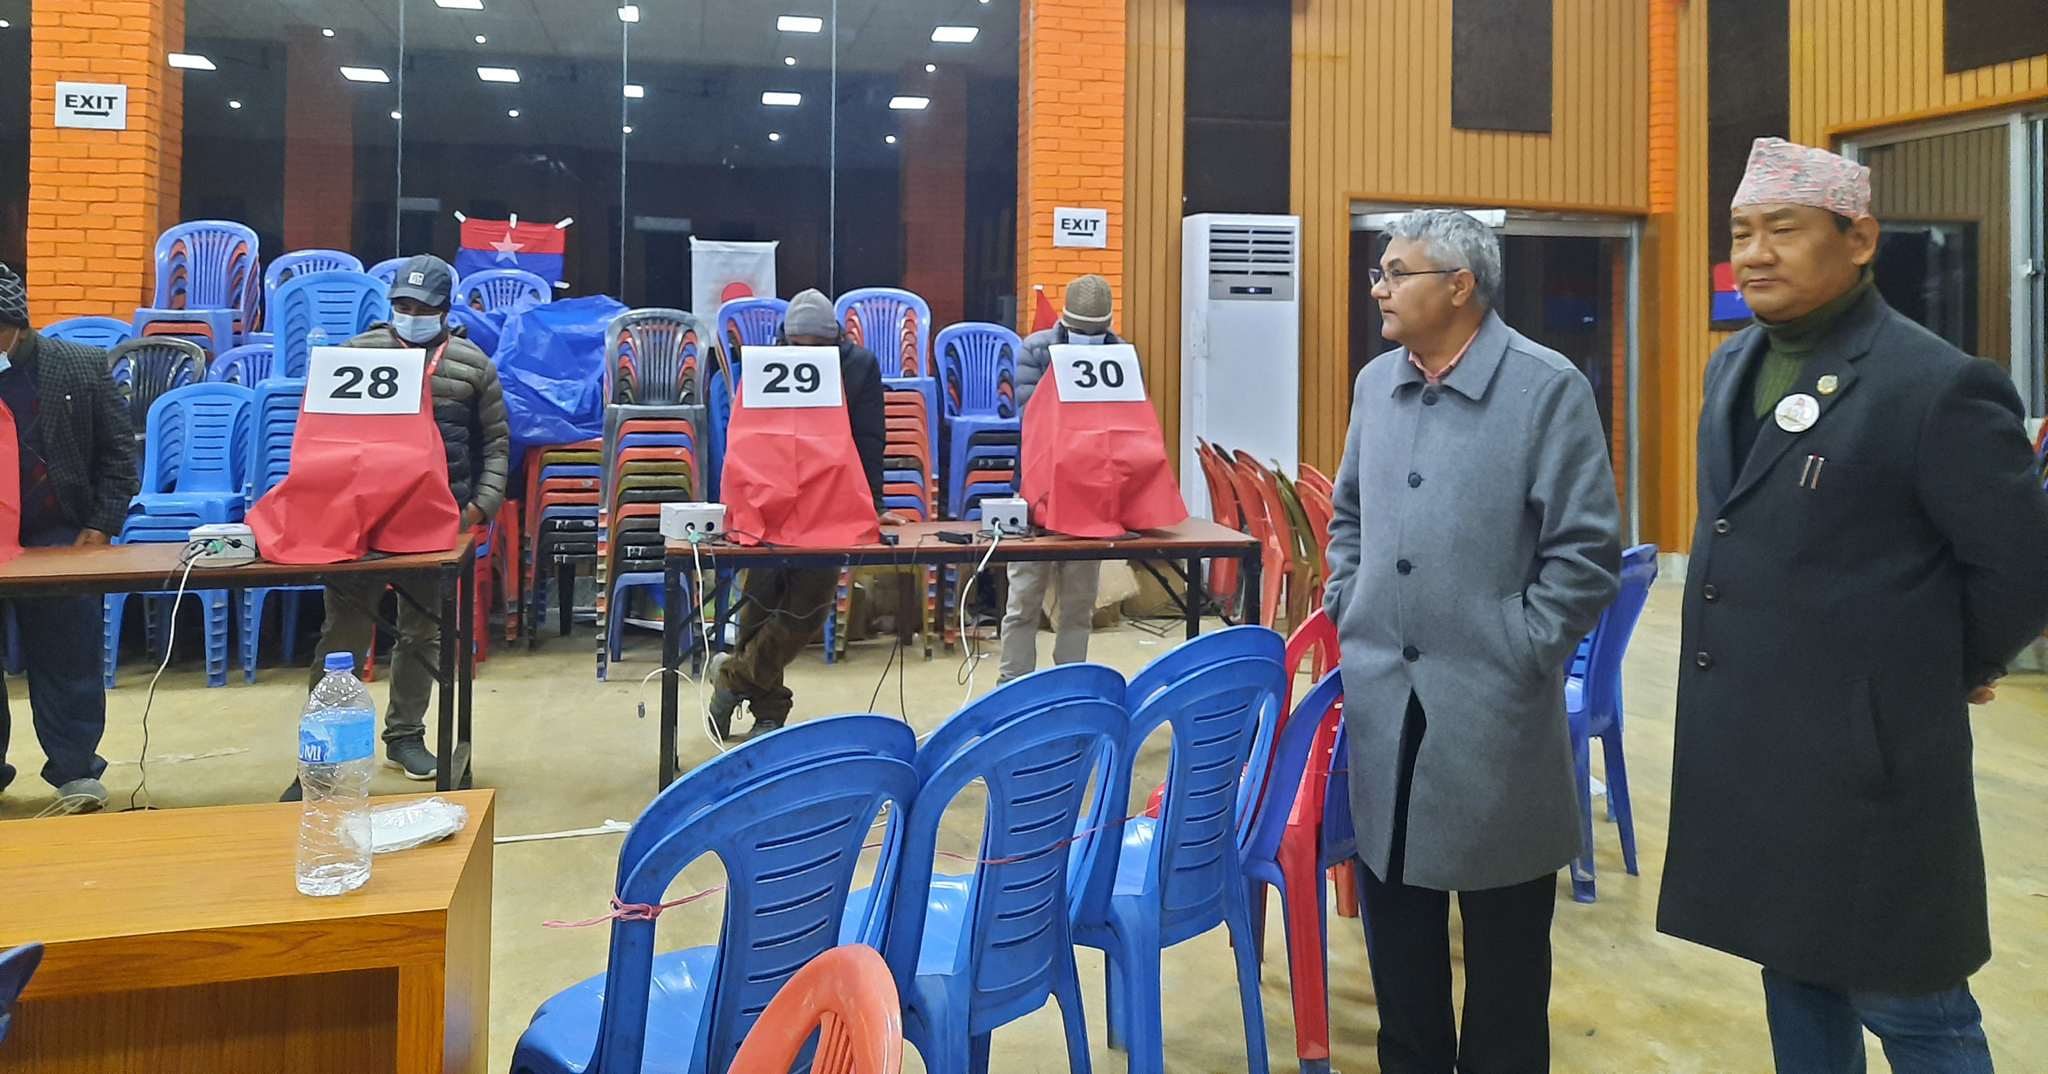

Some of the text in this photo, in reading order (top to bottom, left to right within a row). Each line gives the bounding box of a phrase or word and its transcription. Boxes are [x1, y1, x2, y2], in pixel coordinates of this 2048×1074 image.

[65, 94, 118, 110] EXIT
[1061, 218, 1100, 231] EXIT
[330, 366, 399, 399] 28
[762, 362, 821, 394] 29
[1072, 360, 1124, 388] 30
